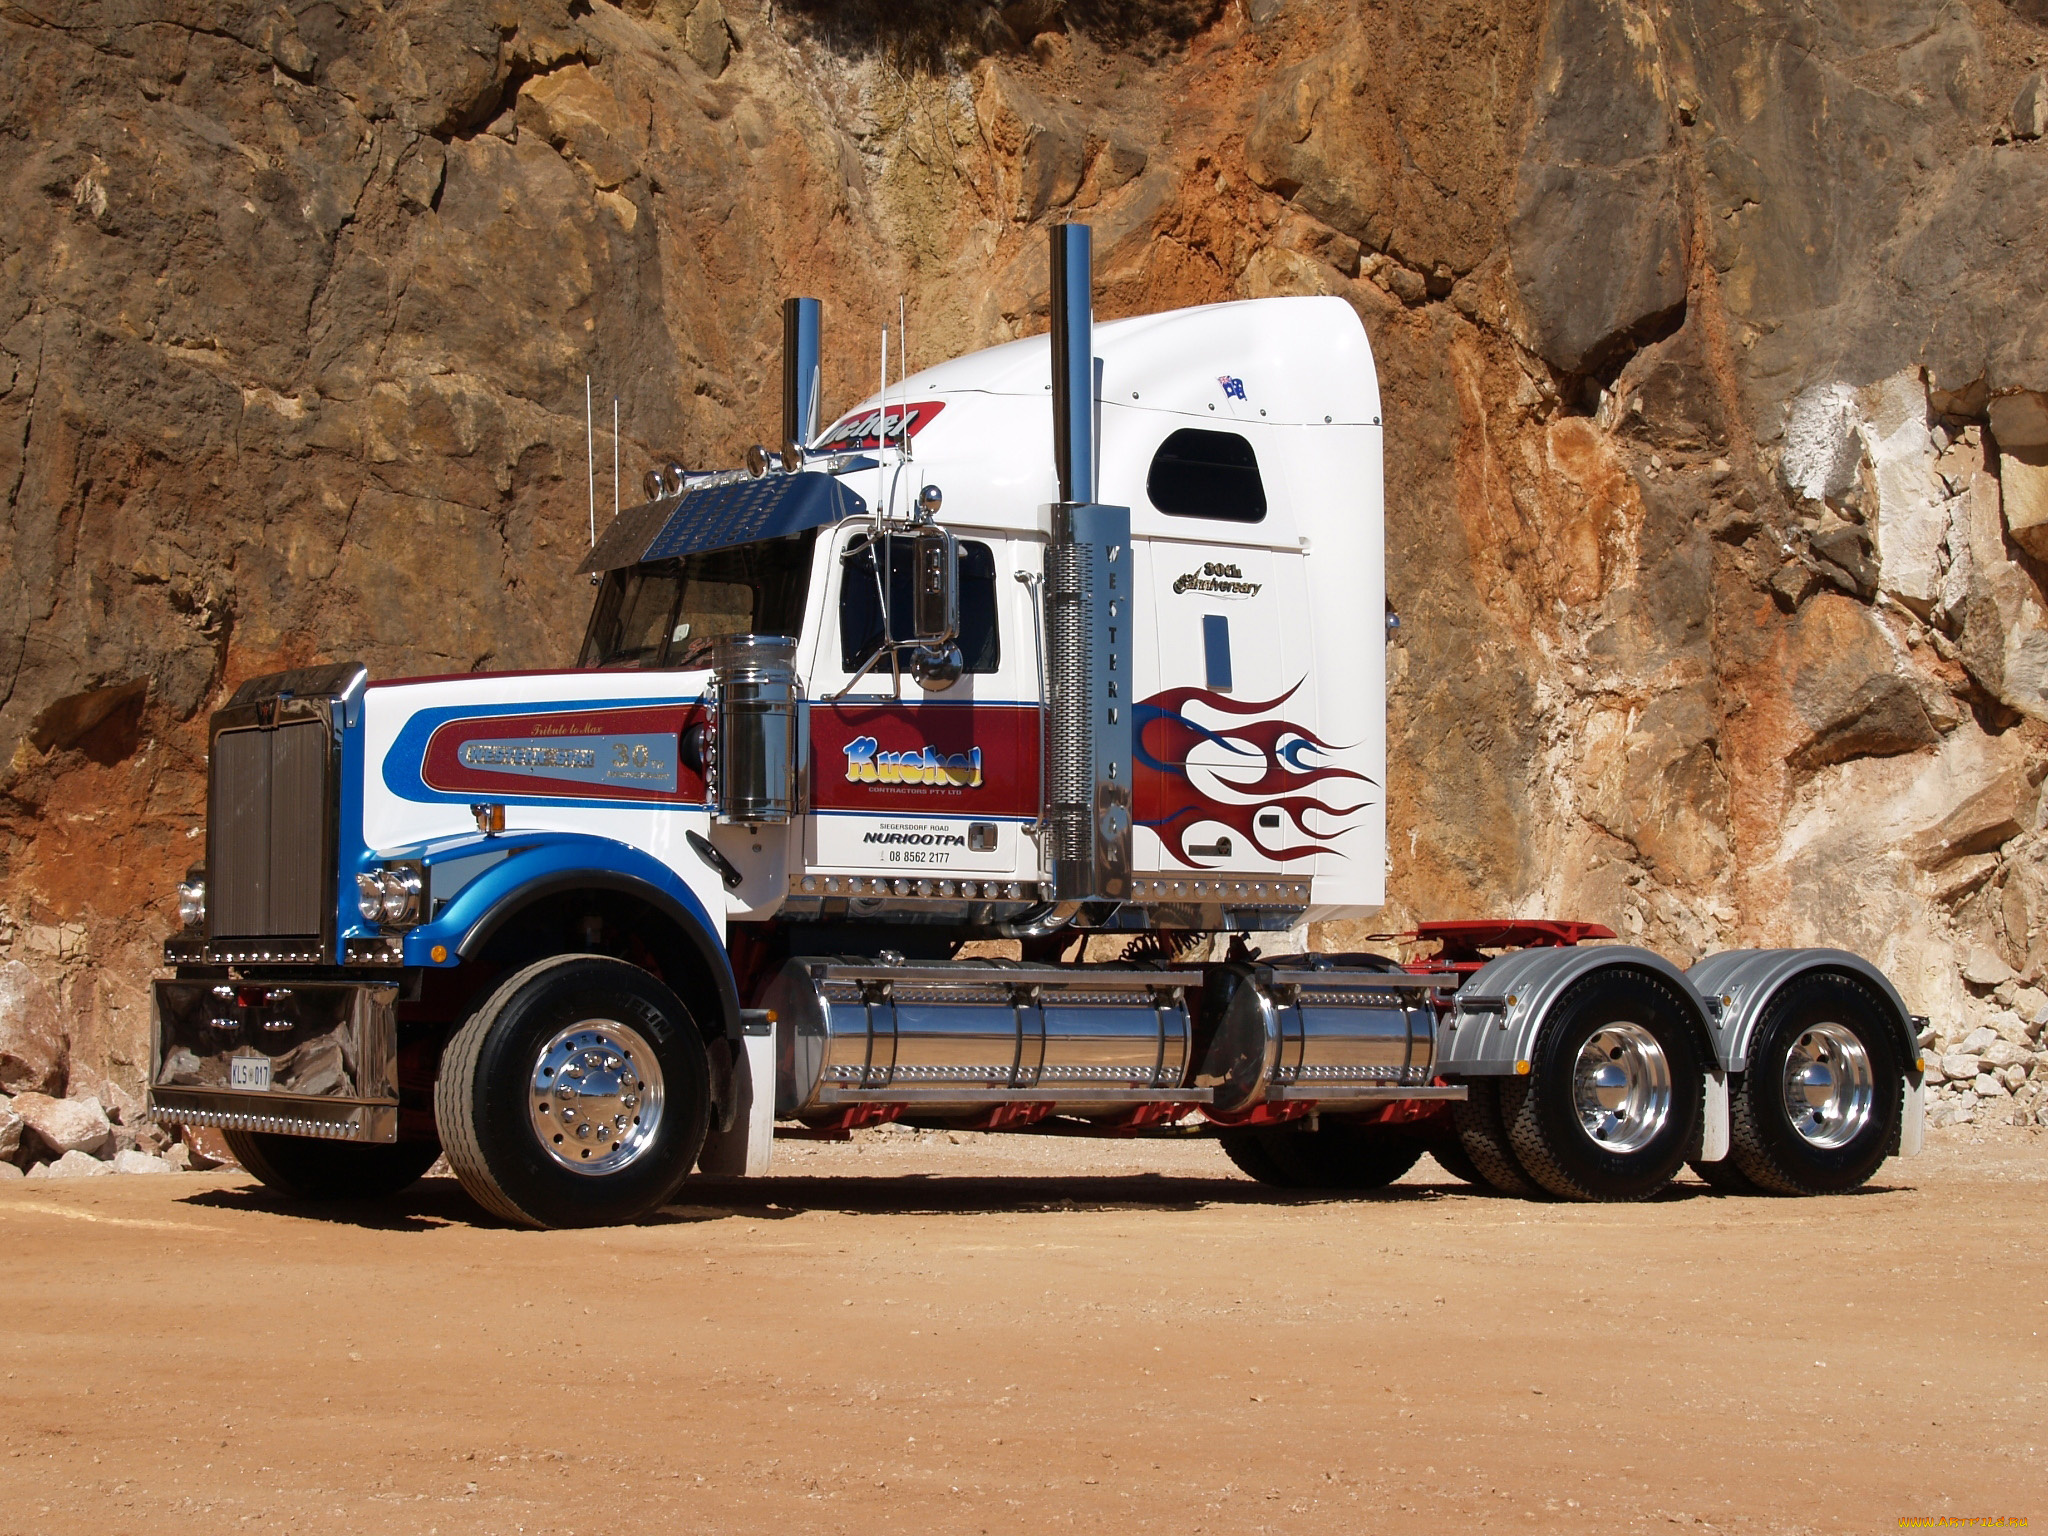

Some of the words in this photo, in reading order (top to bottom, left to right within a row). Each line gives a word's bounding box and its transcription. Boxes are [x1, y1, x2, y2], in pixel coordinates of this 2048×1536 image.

[1203, 562, 1243, 579] 30th
[1173, 566, 1263, 598] Anniversary
[1105, 545, 1120, 725] WESTERN
[530, 723, 568, 736] Tribute
[569, 723, 579, 734] to
[580, 722, 604, 734] Max
[466, 744, 545, 766] WESTERN
[552, 749, 595, 768] STAR
[868, 786, 927, 795] CONTRACTORS
[880, 823, 928, 831] SIEGERSDORF
[862, 832, 966, 847] NURIOOTPA
[889, 850, 901, 862] 08
[904, 851, 926, 863] 8562
[928, 852, 950, 864] 2177
